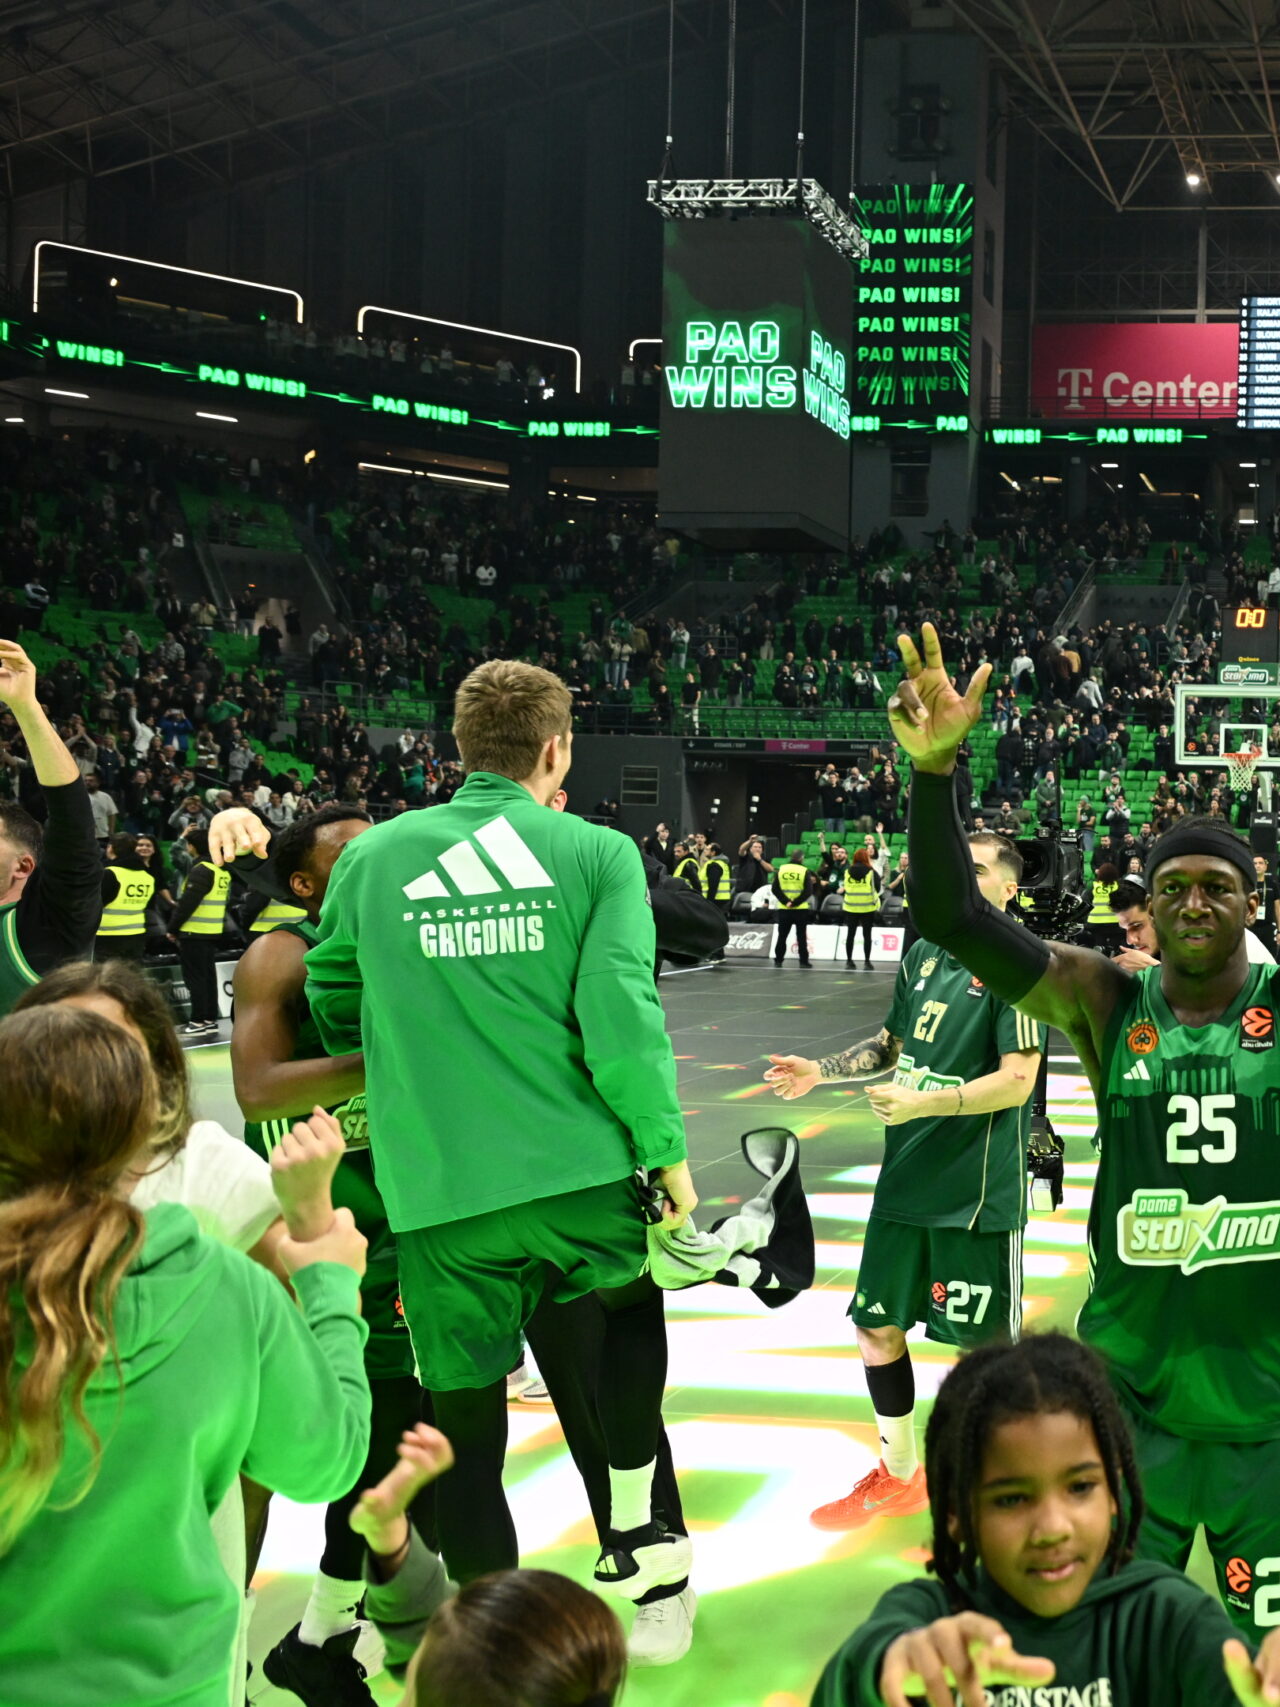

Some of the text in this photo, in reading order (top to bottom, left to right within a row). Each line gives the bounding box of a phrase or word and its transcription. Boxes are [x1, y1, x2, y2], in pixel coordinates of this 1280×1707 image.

[861, 228, 961, 244] PAO WINS!
[860, 258, 960, 273] PAO WINS!
[859, 287, 960, 303] PAO WINS!
[858, 317, 959, 332] PAO WINS!
[686, 321, 780, 363] PAO
[57, 341, 124, 367] WINS!
[811, 330, 846, 393] PAO
[858, 347, 958, 361] PAO WINS!
[199, 365, 306, 397] PAO WINS!
[665, 366, 797, 408] WINS
[1058, 368, 1237, 410] T Center
[373, 395, 468, 425] PAO WINS!
[803, 368, 851, 440] WINS
[528, 422, 610, 436] PAO WINS!
[852, 416, 880, 431] NS!
[937, 416, 968, 431] PAO
[993, 429, 1041, 443] WINS!
[1097, 428, 1183, 443] PAO WINS!
[781, 872, 801, 881] CSI
[125, 884, 150, 898] CSI
[403, 900, 557, 922] BASKETBALL
[419, 915, 545, 959] GRIGONIS
[913, 1000, 948, 1043] 27
[1166, 1094, 1237, 1163] 25
[1138, 1197, 1177, 1215] pame
[946, 1280, 992, 1324] 27
